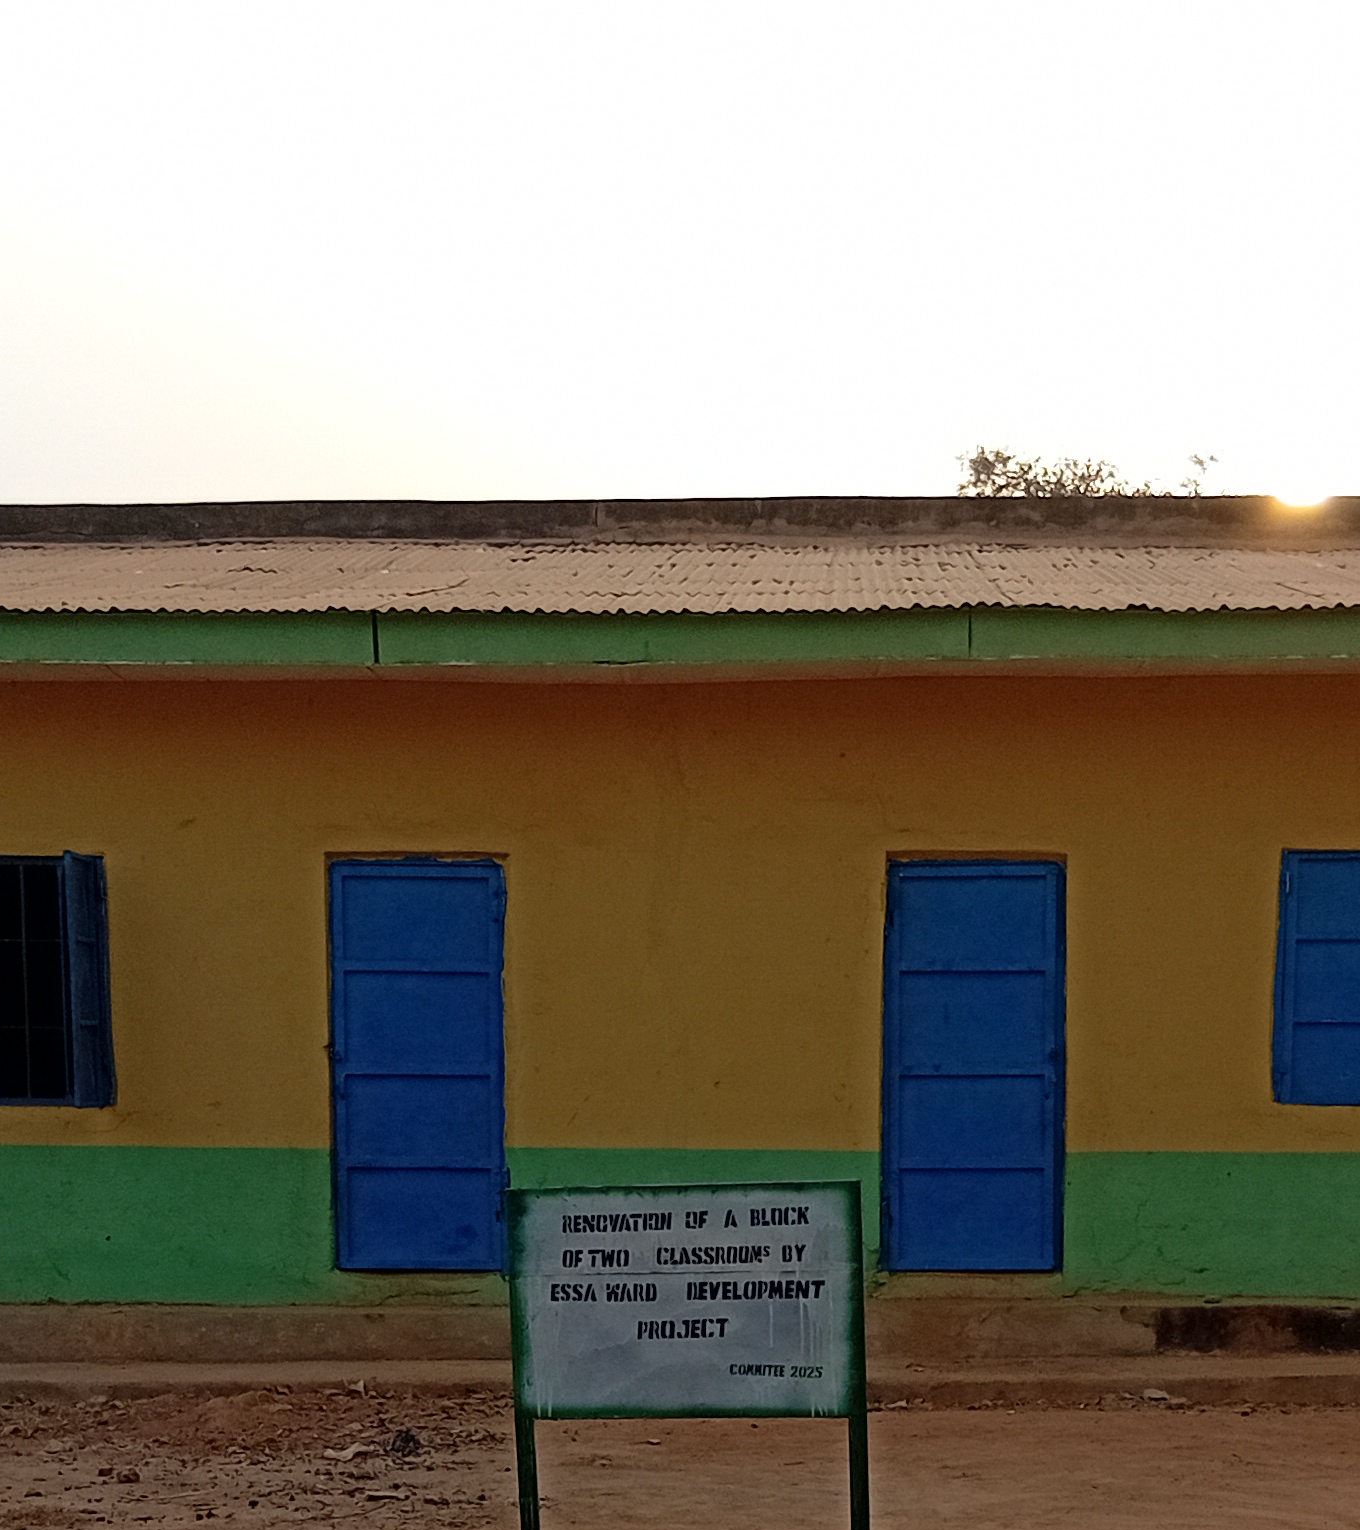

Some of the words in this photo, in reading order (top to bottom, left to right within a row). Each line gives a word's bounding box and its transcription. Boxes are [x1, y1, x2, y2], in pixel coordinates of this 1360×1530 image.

[562, 1212, 672, 1233] RENOVATION
[685, 1211, 708, 1229] OF
[724, 1210, 738, 1228] A
[750, 1207, 810, 1226] BLOCK
[562, 1250, 583, 1268] OF
[589, 1249, 630, 1268] TWO
[782, 1245, 806, 1263] BY
[550, 1283, 597, 1302] ESSA
[606, 1283, 657, 1302] WARD
[686, 1280, 825, 1300] DEVELOPMENT
[637, 1318, 729, 1340] PROJECT
[790, 1365, 823, 1378] 2025
